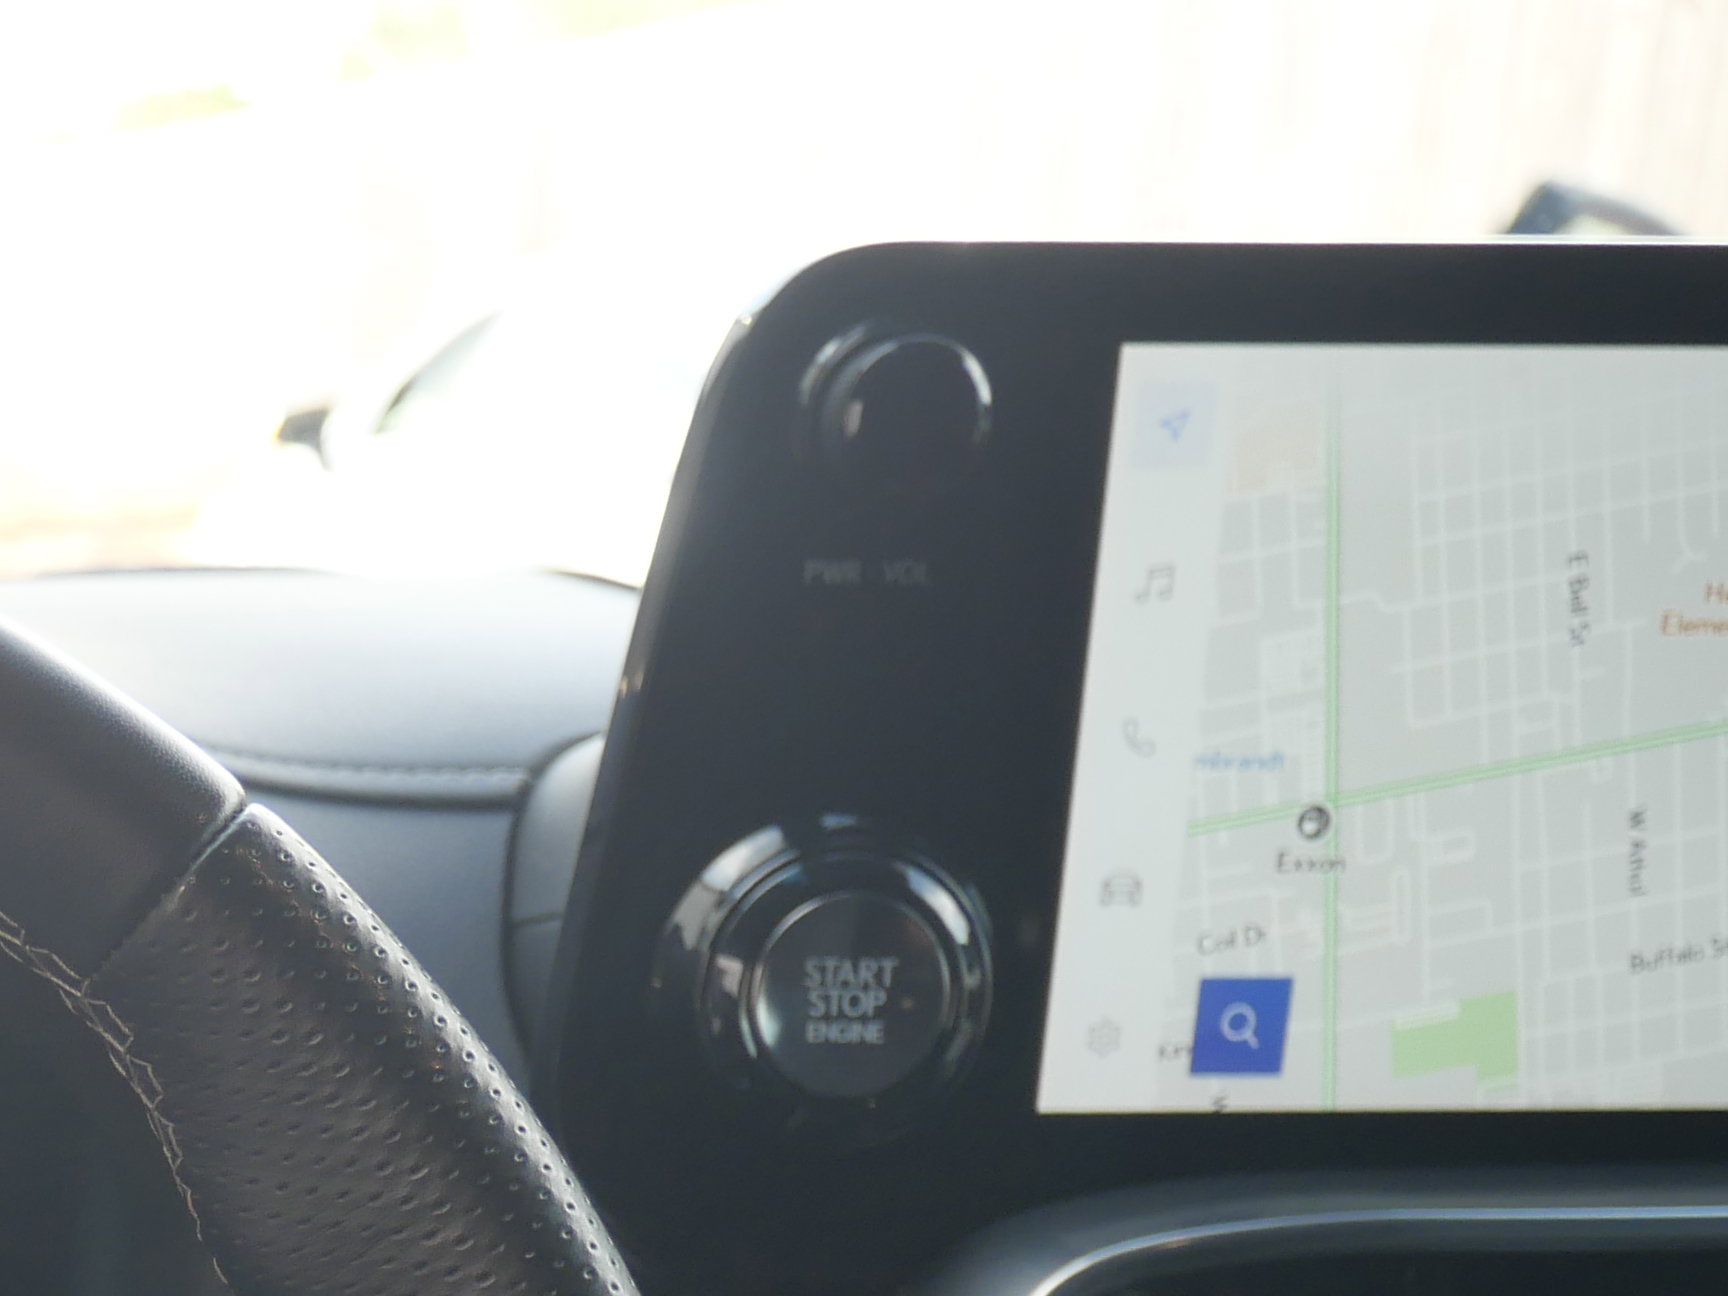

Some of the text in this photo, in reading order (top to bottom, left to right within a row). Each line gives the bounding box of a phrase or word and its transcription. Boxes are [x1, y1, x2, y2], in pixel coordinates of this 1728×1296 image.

[805, 956, 899, 987] START
[806, 986, 887, 1018] STOP
[803, 1018, 885, 1044] ENGINE
